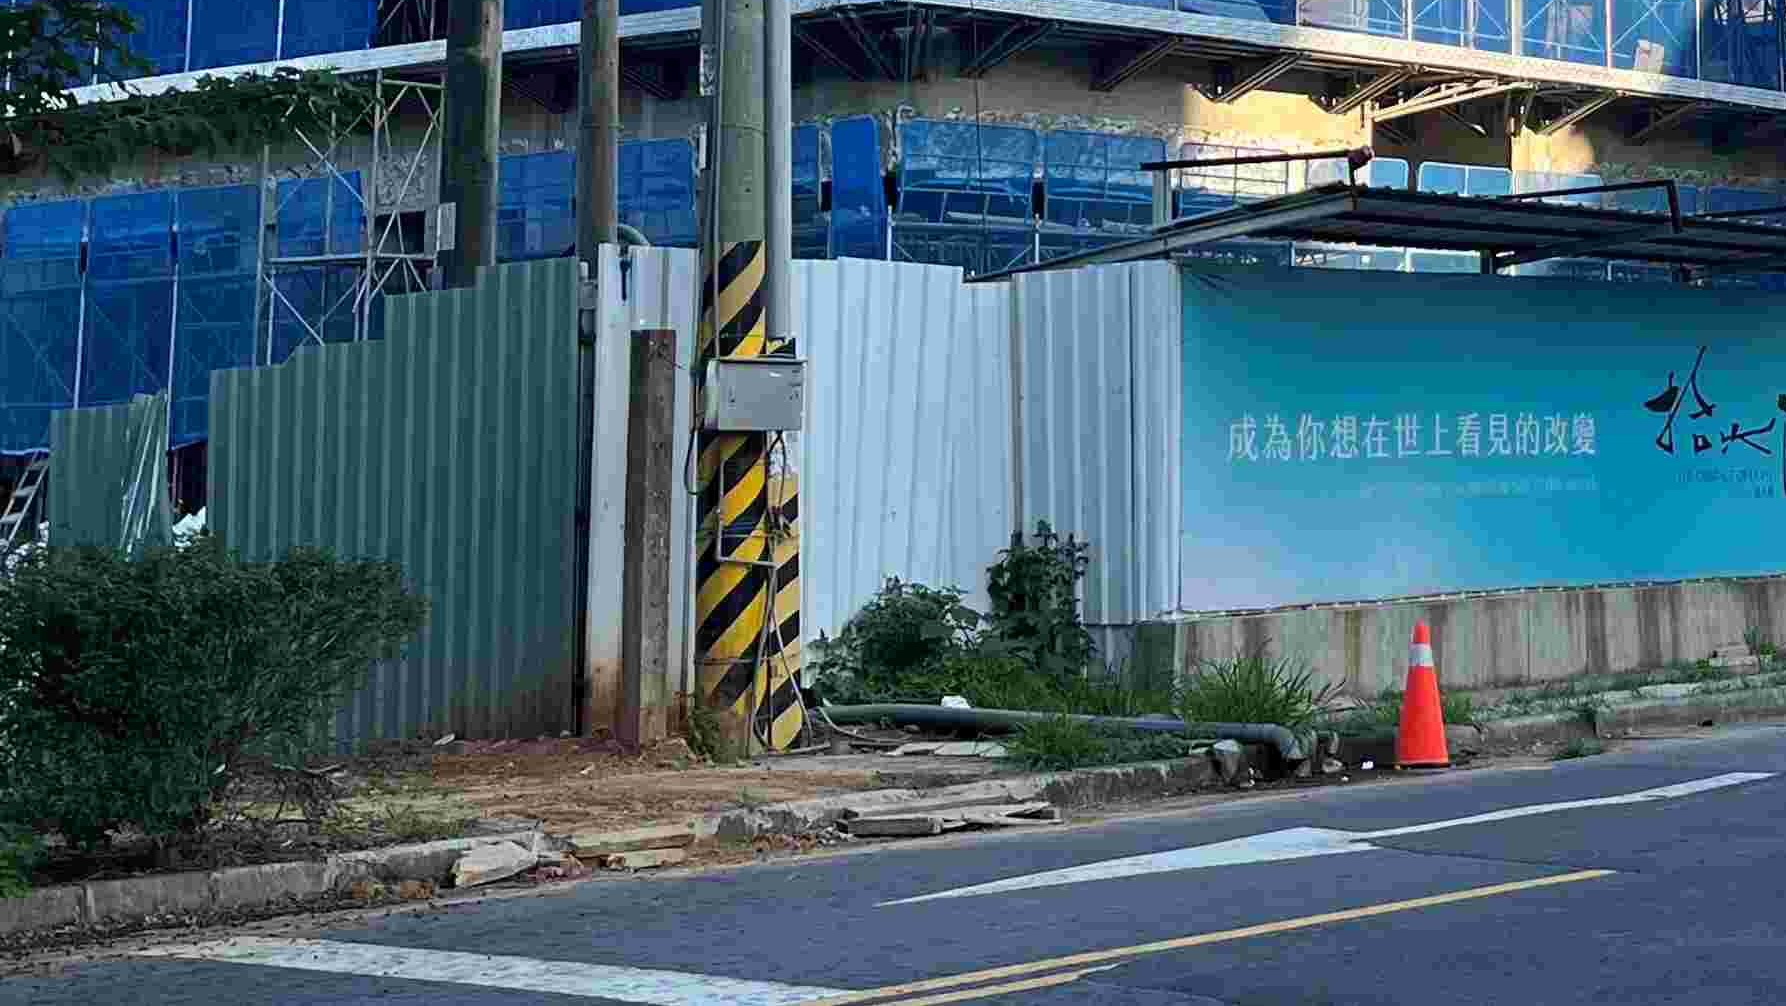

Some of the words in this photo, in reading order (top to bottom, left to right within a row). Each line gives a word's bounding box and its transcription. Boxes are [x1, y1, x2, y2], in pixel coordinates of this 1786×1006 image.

[1225, 411, 1598, 461] 成為你想在世上看見的改變
